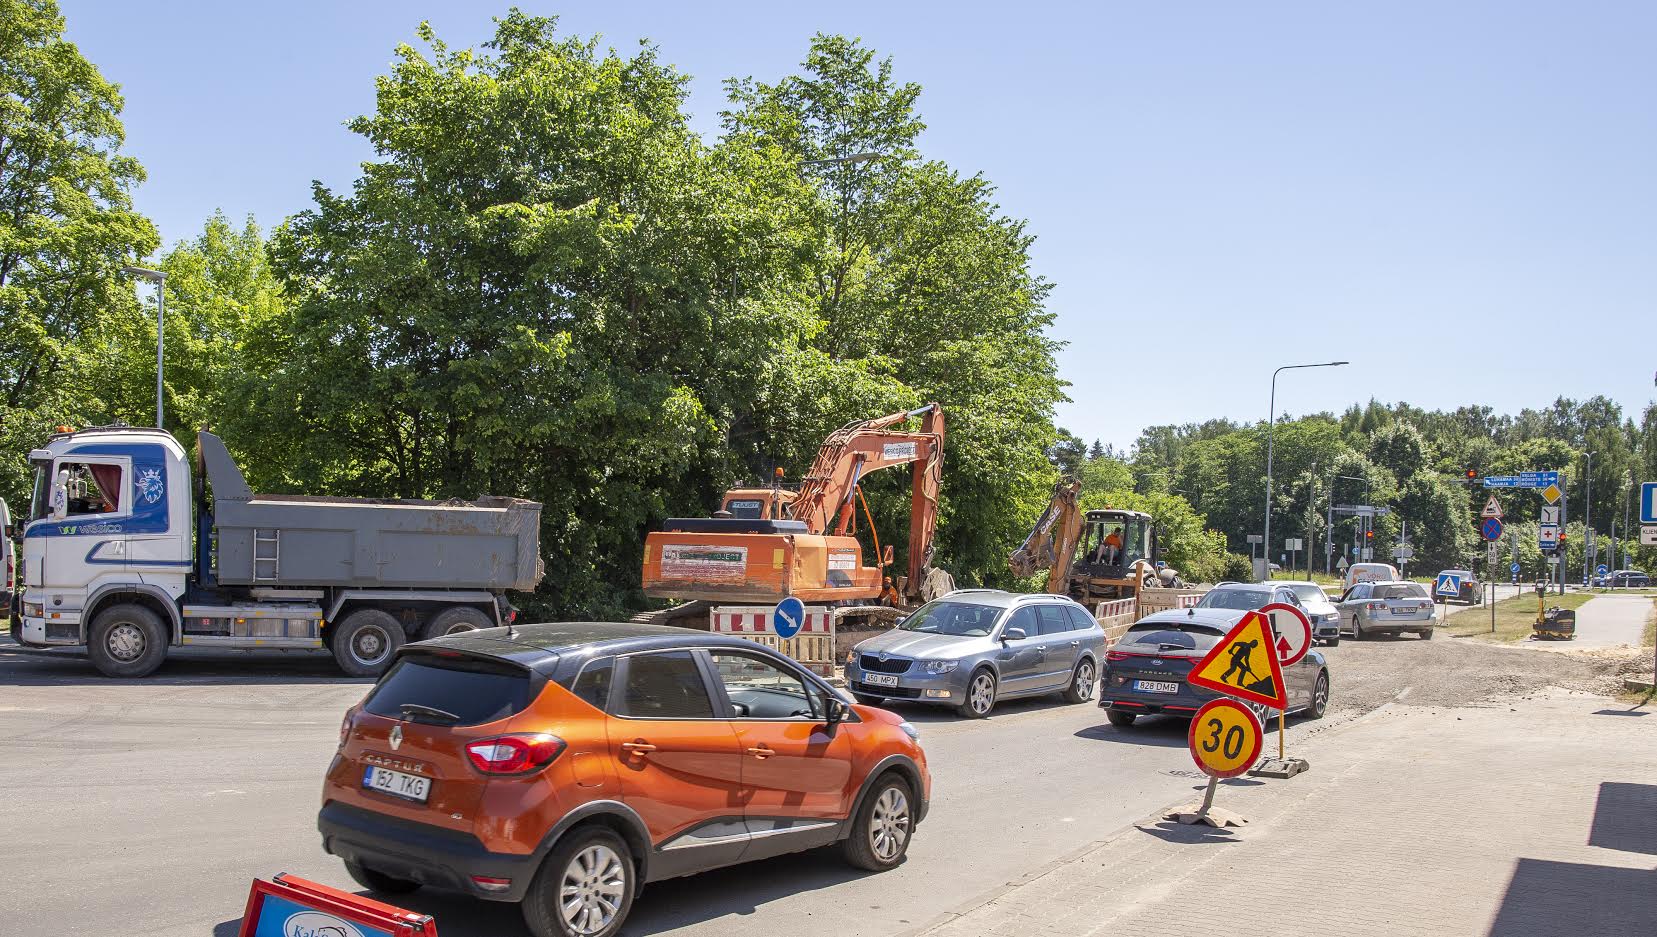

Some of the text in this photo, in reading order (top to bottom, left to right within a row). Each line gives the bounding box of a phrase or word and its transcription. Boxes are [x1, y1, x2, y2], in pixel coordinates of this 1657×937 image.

[1040, 505, 1061, 535] CASE
[880, 676, 896, 685] MPX
[1140, 681, 1177, 692] 828 DMB
[1202, 718, 1245, 760] 30
[366, 754, 424, 773] CAPTUR
[375, 770, 424, 796] 152 TKG
